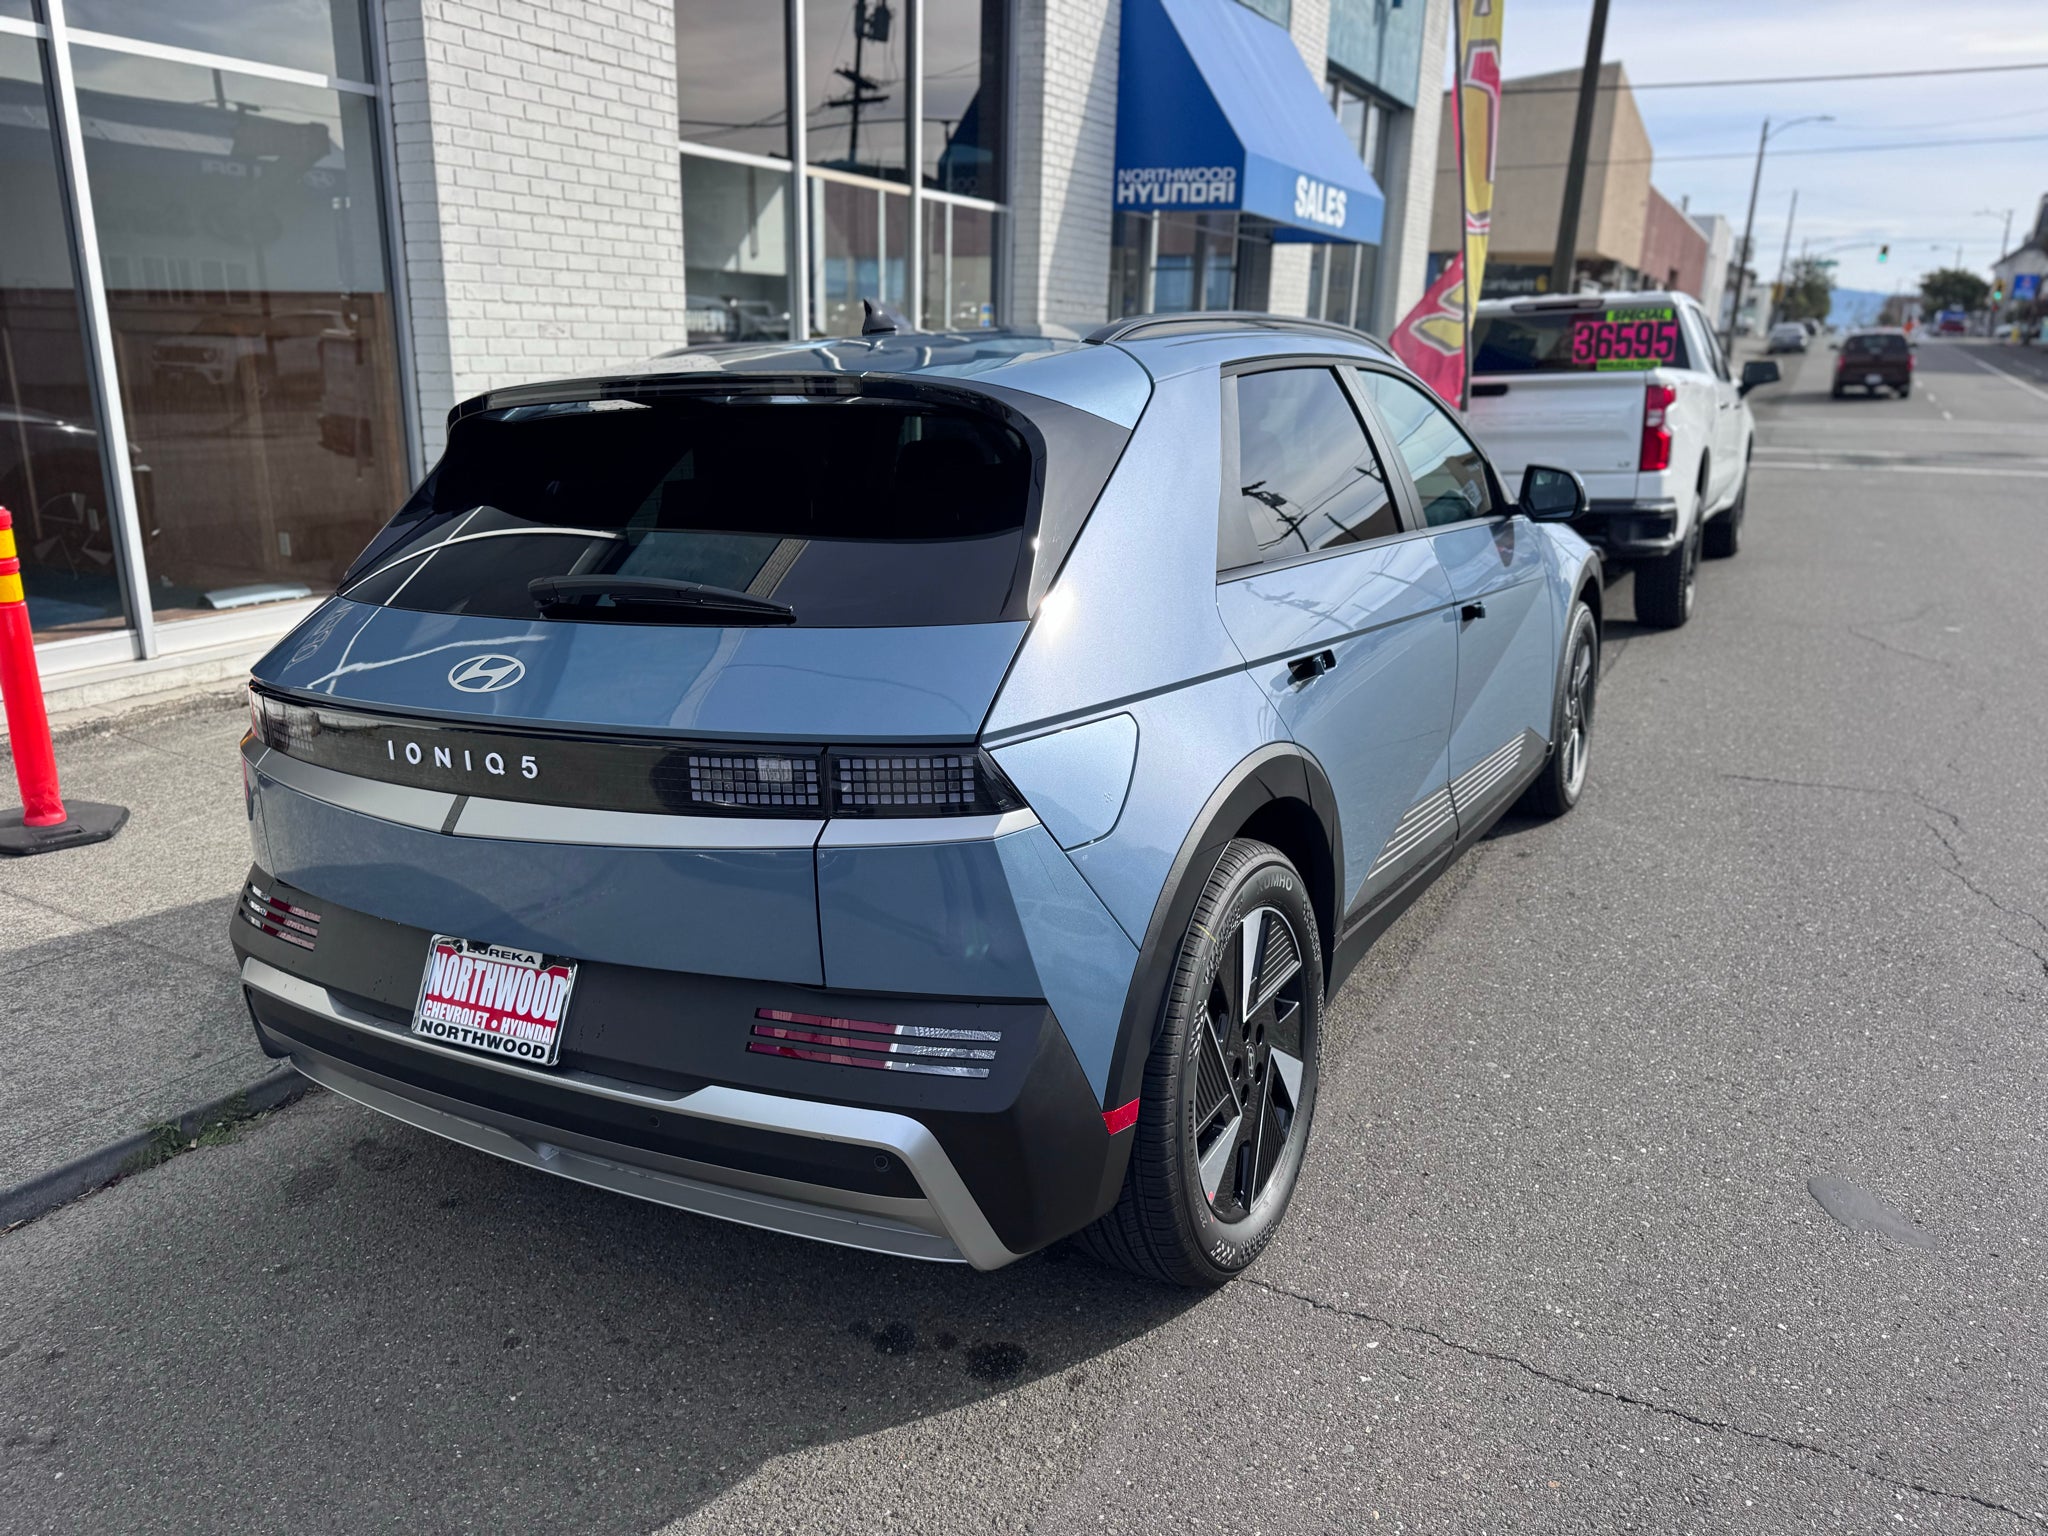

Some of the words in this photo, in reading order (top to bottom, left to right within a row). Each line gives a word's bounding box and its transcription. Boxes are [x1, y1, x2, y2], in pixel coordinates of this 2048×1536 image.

[1117, 182, 1236, 204] HYUNDAI
[1118, 166, 1236, 183] NORTHWOOD
[1294, 175, 1347, 228] SALES
[1574, 321, 1677, 361] 36595
[387, 740, 506, 775] IONIQ
[521, 755, 539, 779] 5
[427, 951, 568, 1022] NORTHWOOD
[420, 1019, 546, 1059] NORTHWOOD
[423, 1000, 490, 1030] CHEVROLET
[500, 1016, 557, 1046] HYUNDAI
